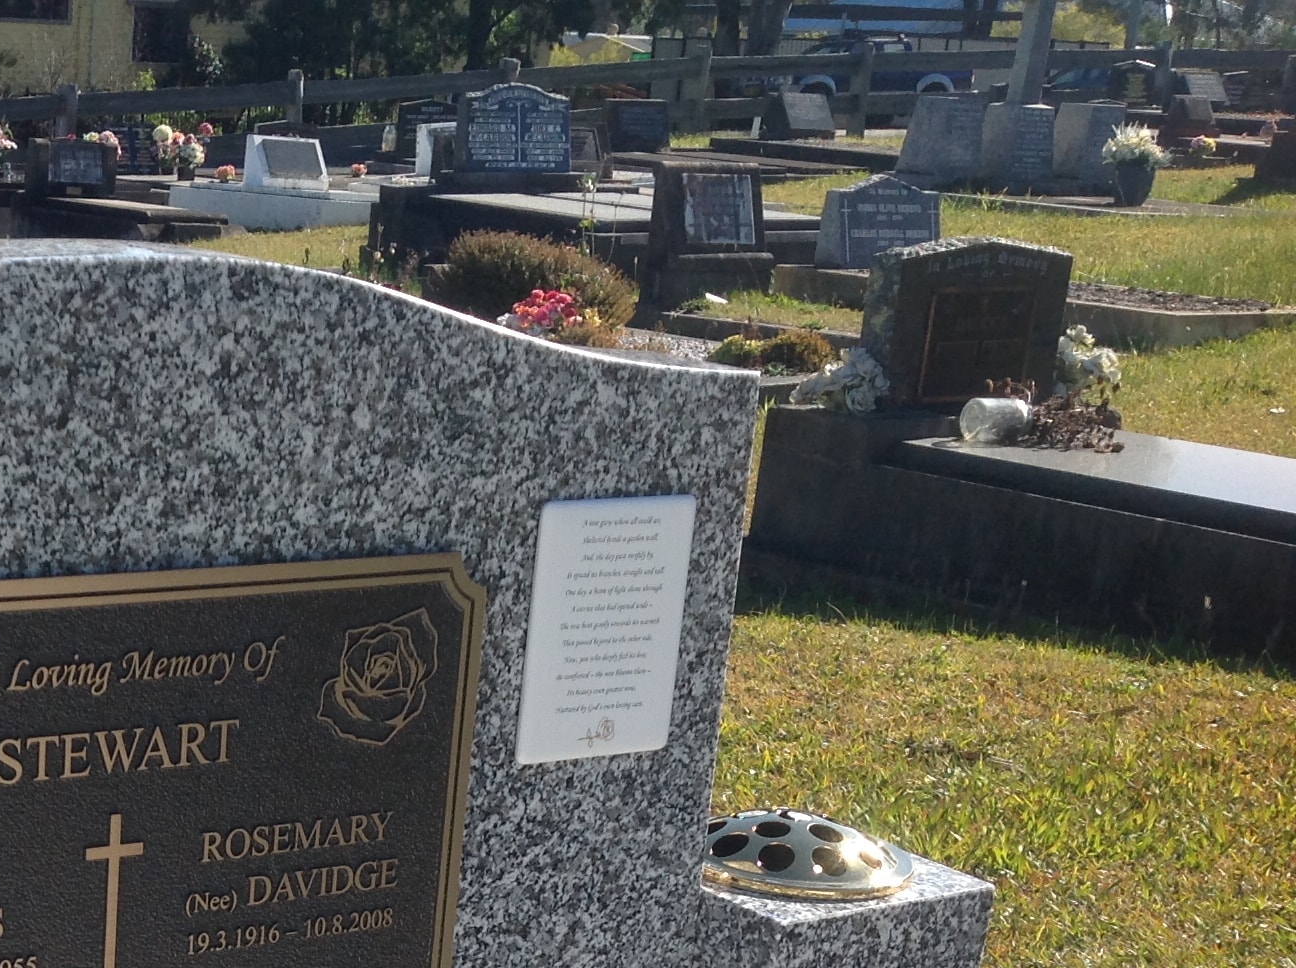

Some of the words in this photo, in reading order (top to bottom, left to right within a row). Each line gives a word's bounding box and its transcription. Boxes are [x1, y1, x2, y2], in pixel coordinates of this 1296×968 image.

[10, 653, 114, 698] Loving
[120, 648, 235, 688] Memory
[243, 635, 286, 679] Of
[201, 811, 394, 864] ROSEMARY
[185, 889, 239, 917] (Nee)
[247, 859, 398, 907] DAVIDGE
[187, 923, 280, 955] 19.3.1916
[303, 908, 393, 940] 10.8.2008
